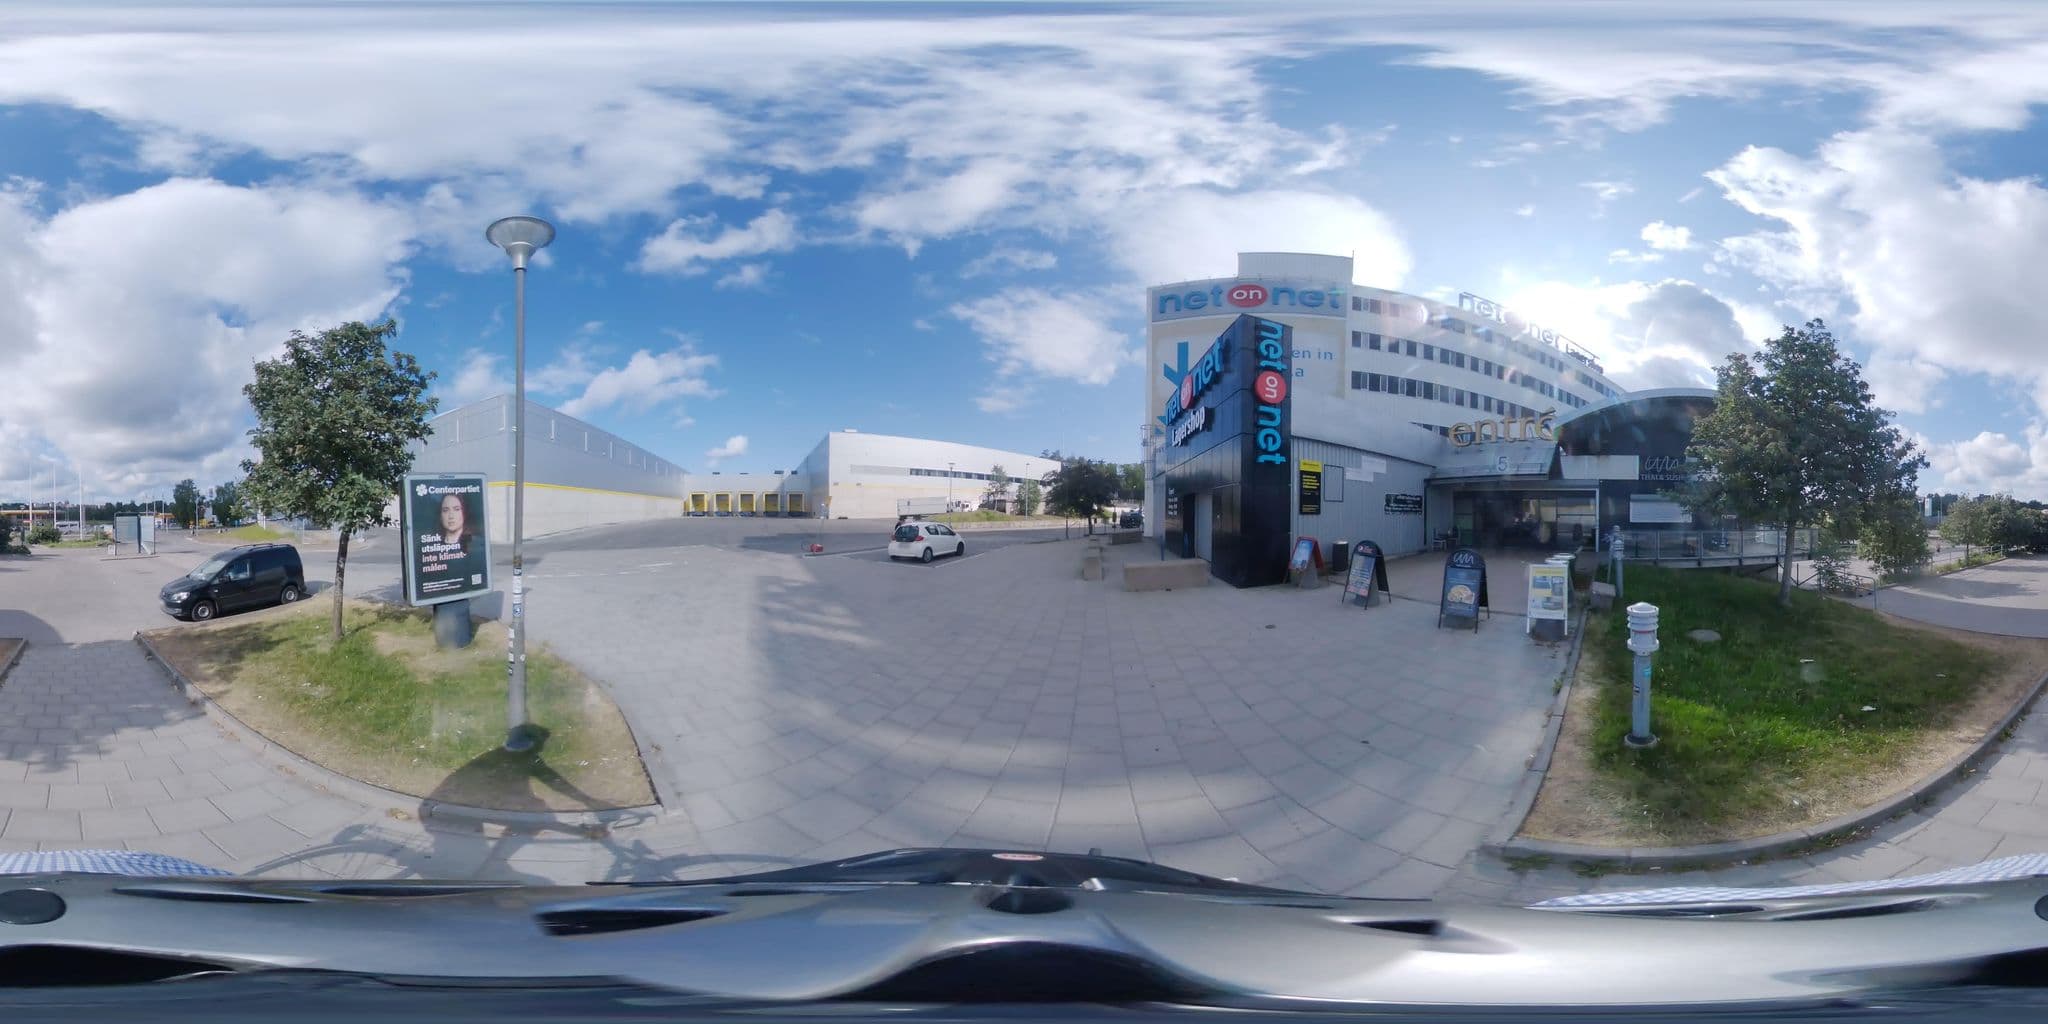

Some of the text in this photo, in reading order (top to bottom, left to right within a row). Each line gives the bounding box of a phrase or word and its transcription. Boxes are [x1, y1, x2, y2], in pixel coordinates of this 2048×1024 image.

[1159, 285, 1344, 314] net on net
[1317, 347, 1333, 360] in
[1165, 388, 1182, 426] net
[1191, 338, 1224, 397] net
[1257, 320, 1288, 464] net on net
[1171, 405, 1206, 448] Lagershop
[1448, 407, 1557, 448] entré
[1496, 456, 1508, 472] 5
[428, 484, 480, 495] Centerpartiet
[421, 533, 442, 544] Sänk
[421, 542, 461, 554] utsläppen
[422, 552, 467, 563] inte klimat-
[422, 563, 448, 573] målen
